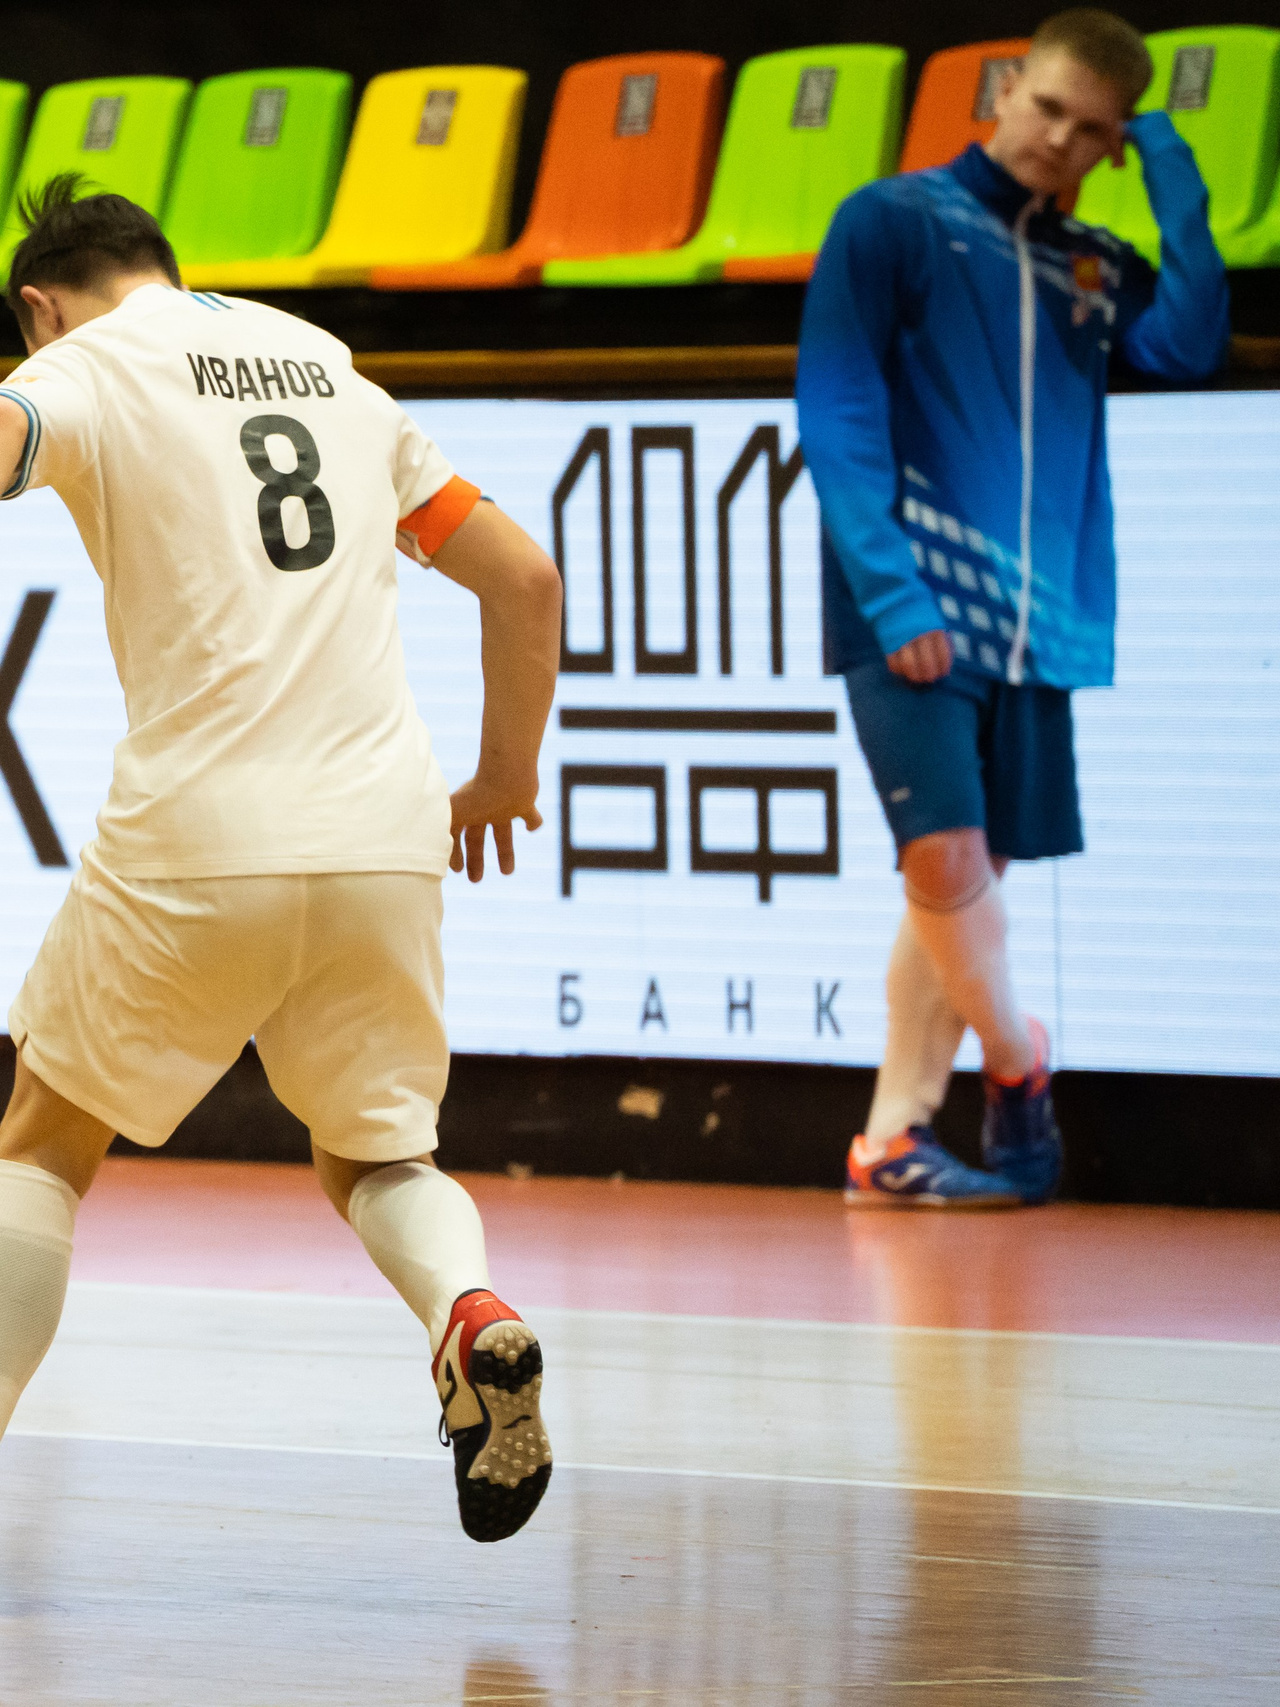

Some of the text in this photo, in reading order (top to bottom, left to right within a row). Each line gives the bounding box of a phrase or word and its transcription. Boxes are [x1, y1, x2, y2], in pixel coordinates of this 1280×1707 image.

[186, 352, 336, 402] ИВАНОВ
[239, 414, 336, 572] 8
[560, 764, 840, 904] РФ
[558, 973, 841, 1037] БАНК
